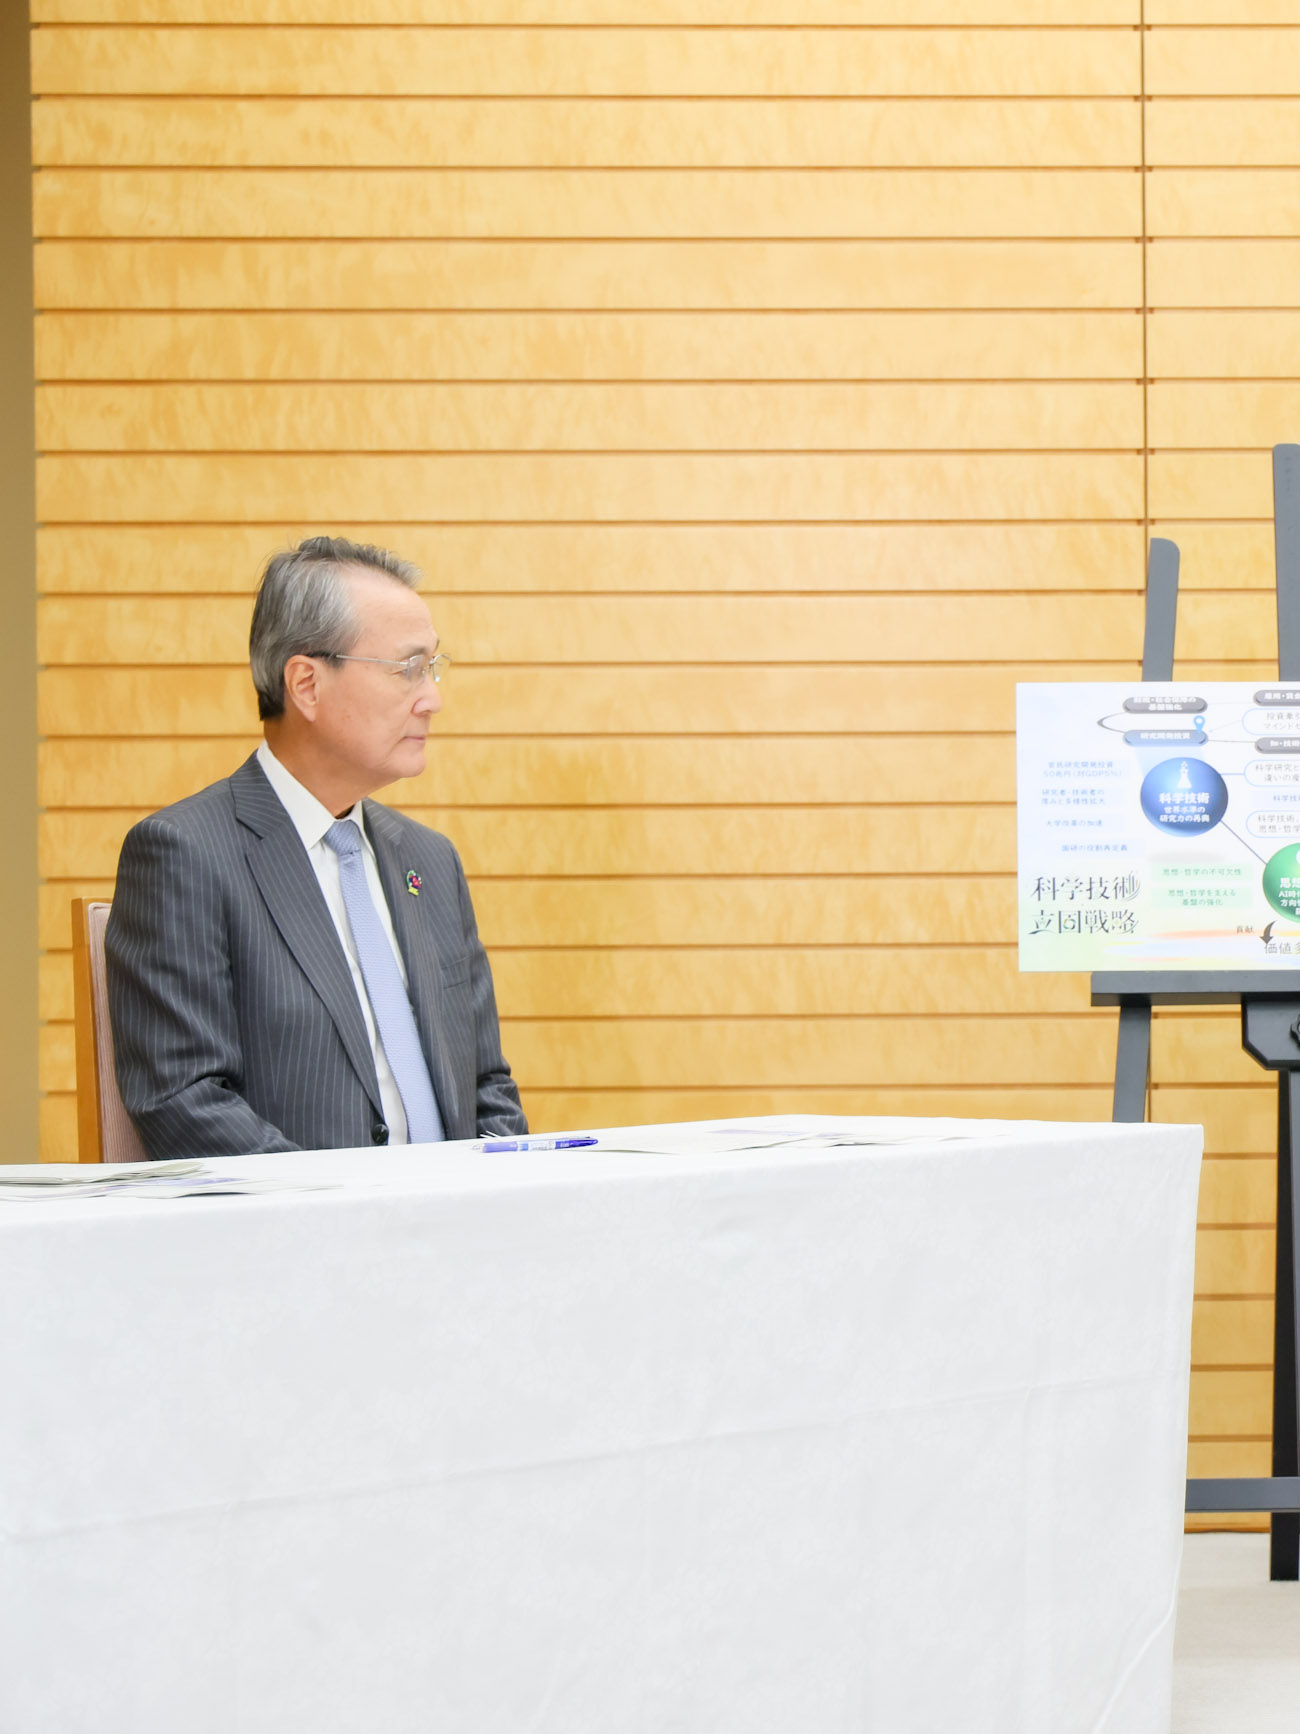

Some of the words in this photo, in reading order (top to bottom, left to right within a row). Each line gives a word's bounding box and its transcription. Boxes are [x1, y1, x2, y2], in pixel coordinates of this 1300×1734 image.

[1159, 792, 1210, 804] 科学技術
[1159, 814, 1210, 823] 研究力の再興
[1163, 868, 1242, 876] 思想・哲学の不可欠性
[1031, 869, 1141, 902] 科学技術
[1168, 889, 1236, 898] 思想・哲学を支える
[1182, 898, 1224, 906] 基盤の強化
[1028, 908, 1140, 935] 立国戦略
[1236, 925, 1254, 934] 貢献
